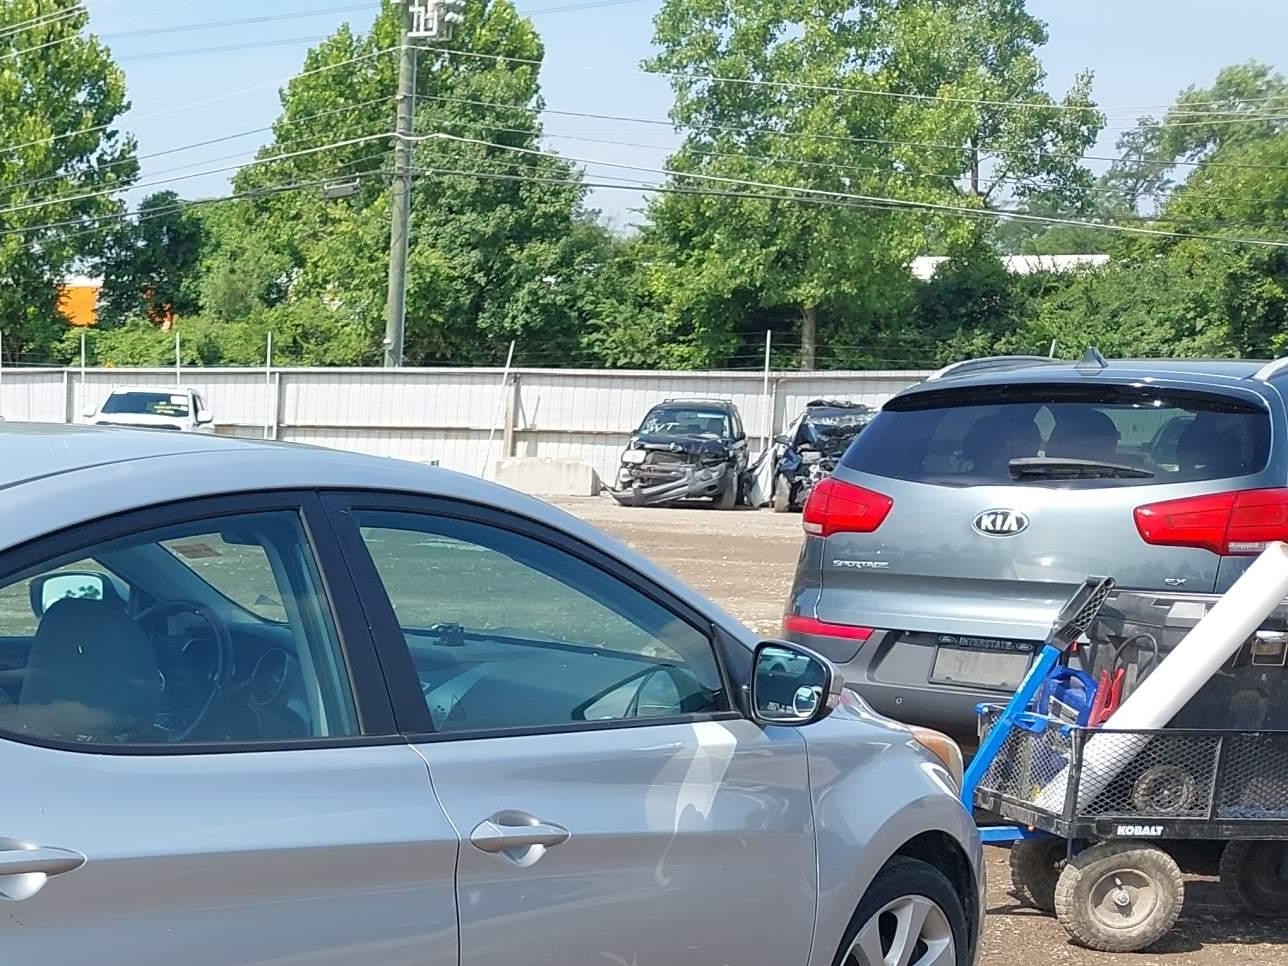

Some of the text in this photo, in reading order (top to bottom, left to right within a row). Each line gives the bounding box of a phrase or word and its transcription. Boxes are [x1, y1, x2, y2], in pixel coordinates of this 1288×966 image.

[980, 513, 1018, 531] KIA
[832, 559, 890, 569] SPORTAGE
[1164, 577, 1187, 587] EX
[1116, 825, 1164, 836] KOBALT
